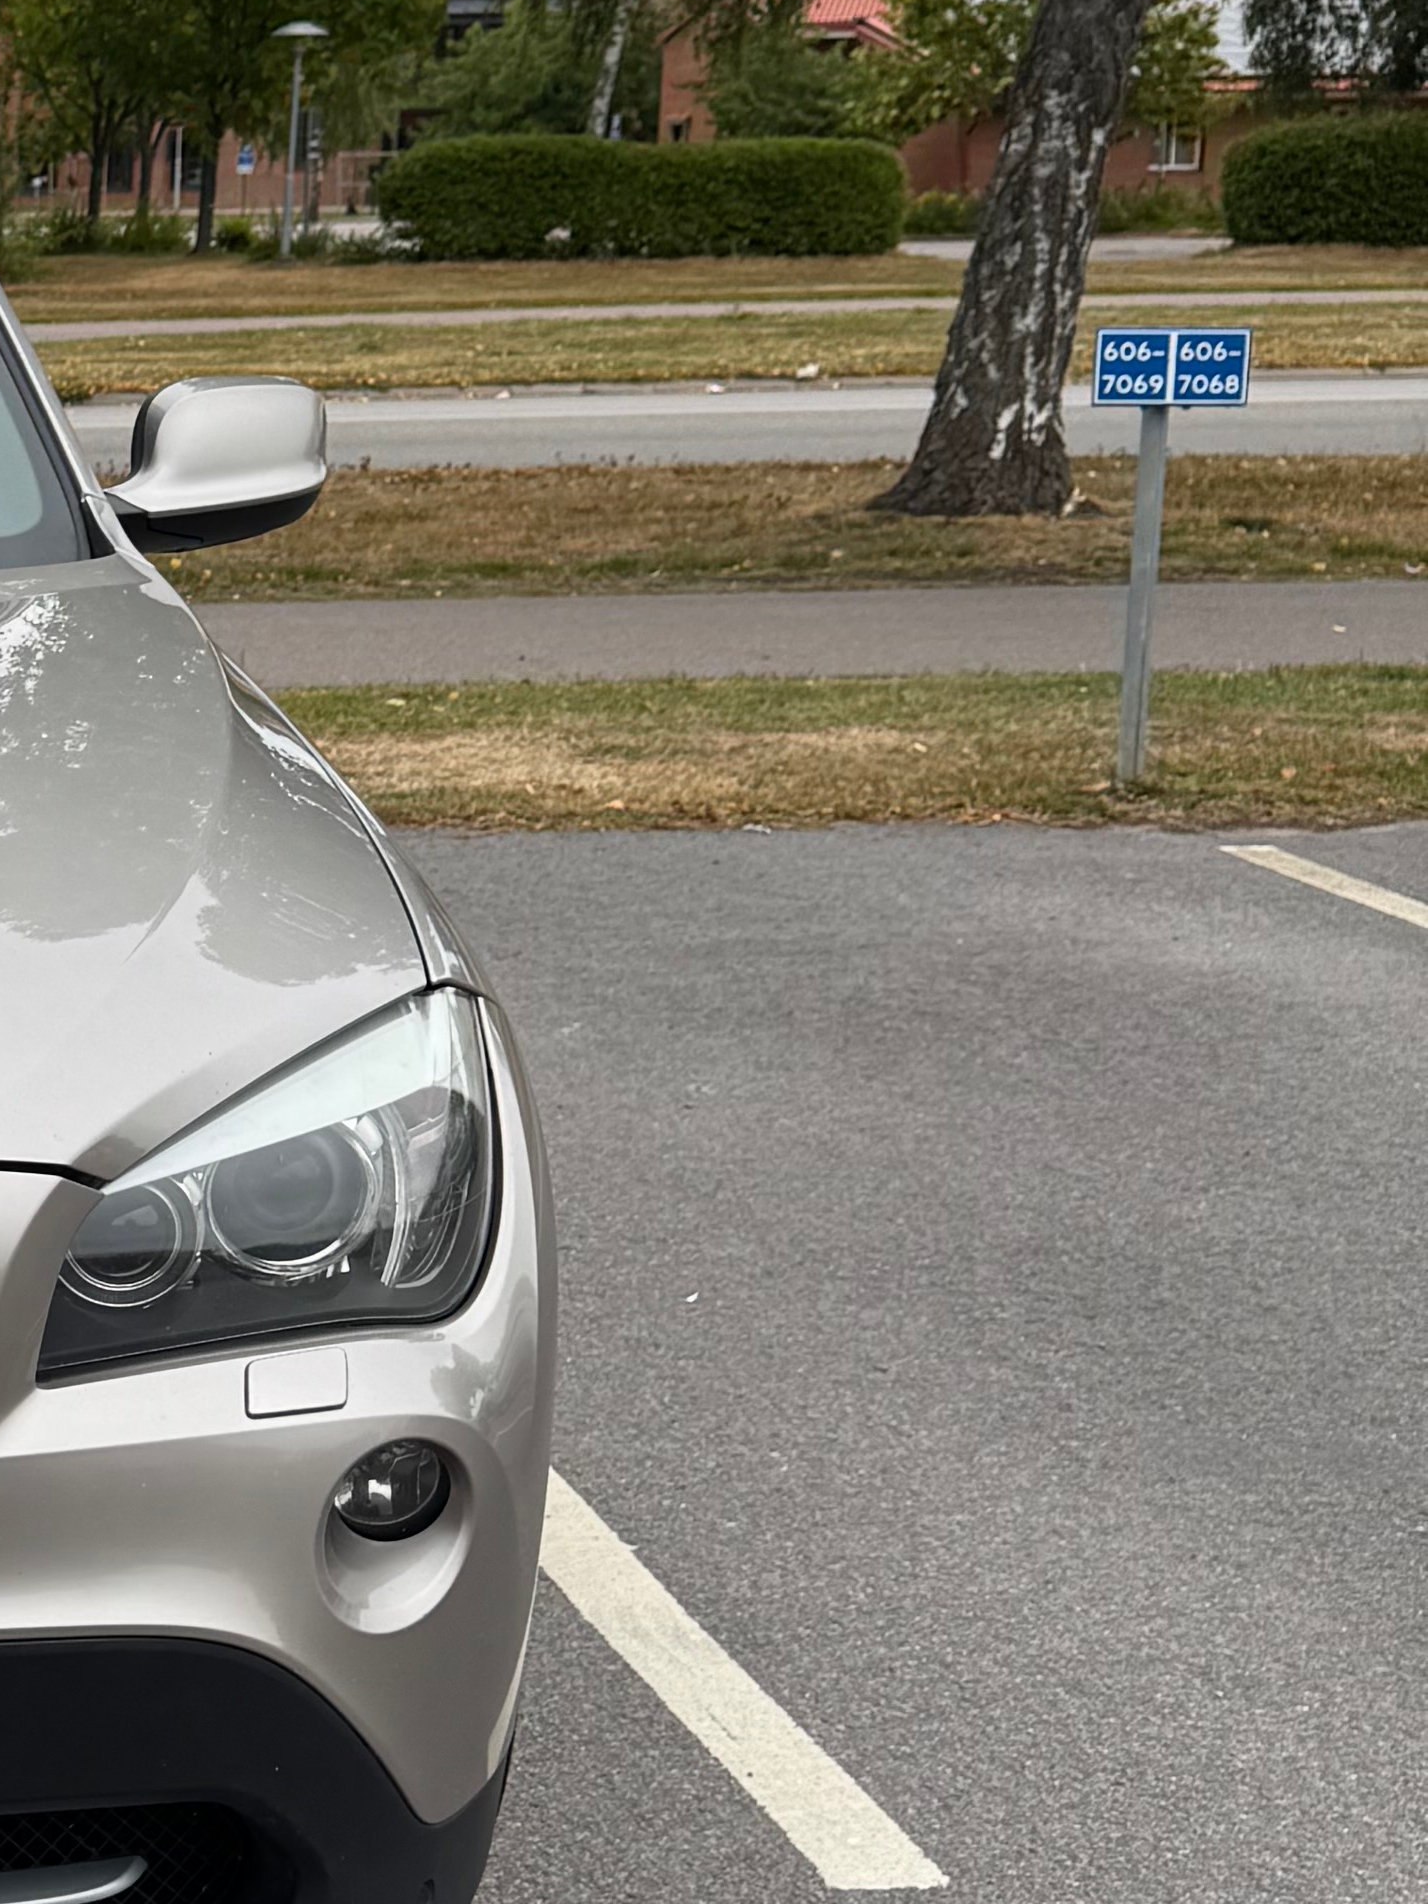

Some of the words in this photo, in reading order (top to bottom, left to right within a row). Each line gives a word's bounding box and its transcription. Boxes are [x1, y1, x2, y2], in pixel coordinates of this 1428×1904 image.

[1103, 341, 1165, 362] 606-
[1179, 341, 1241, 362] 606-
[1101, 374, 1164, 394] 7069
[1177, 374, 1239, 394] 7068
